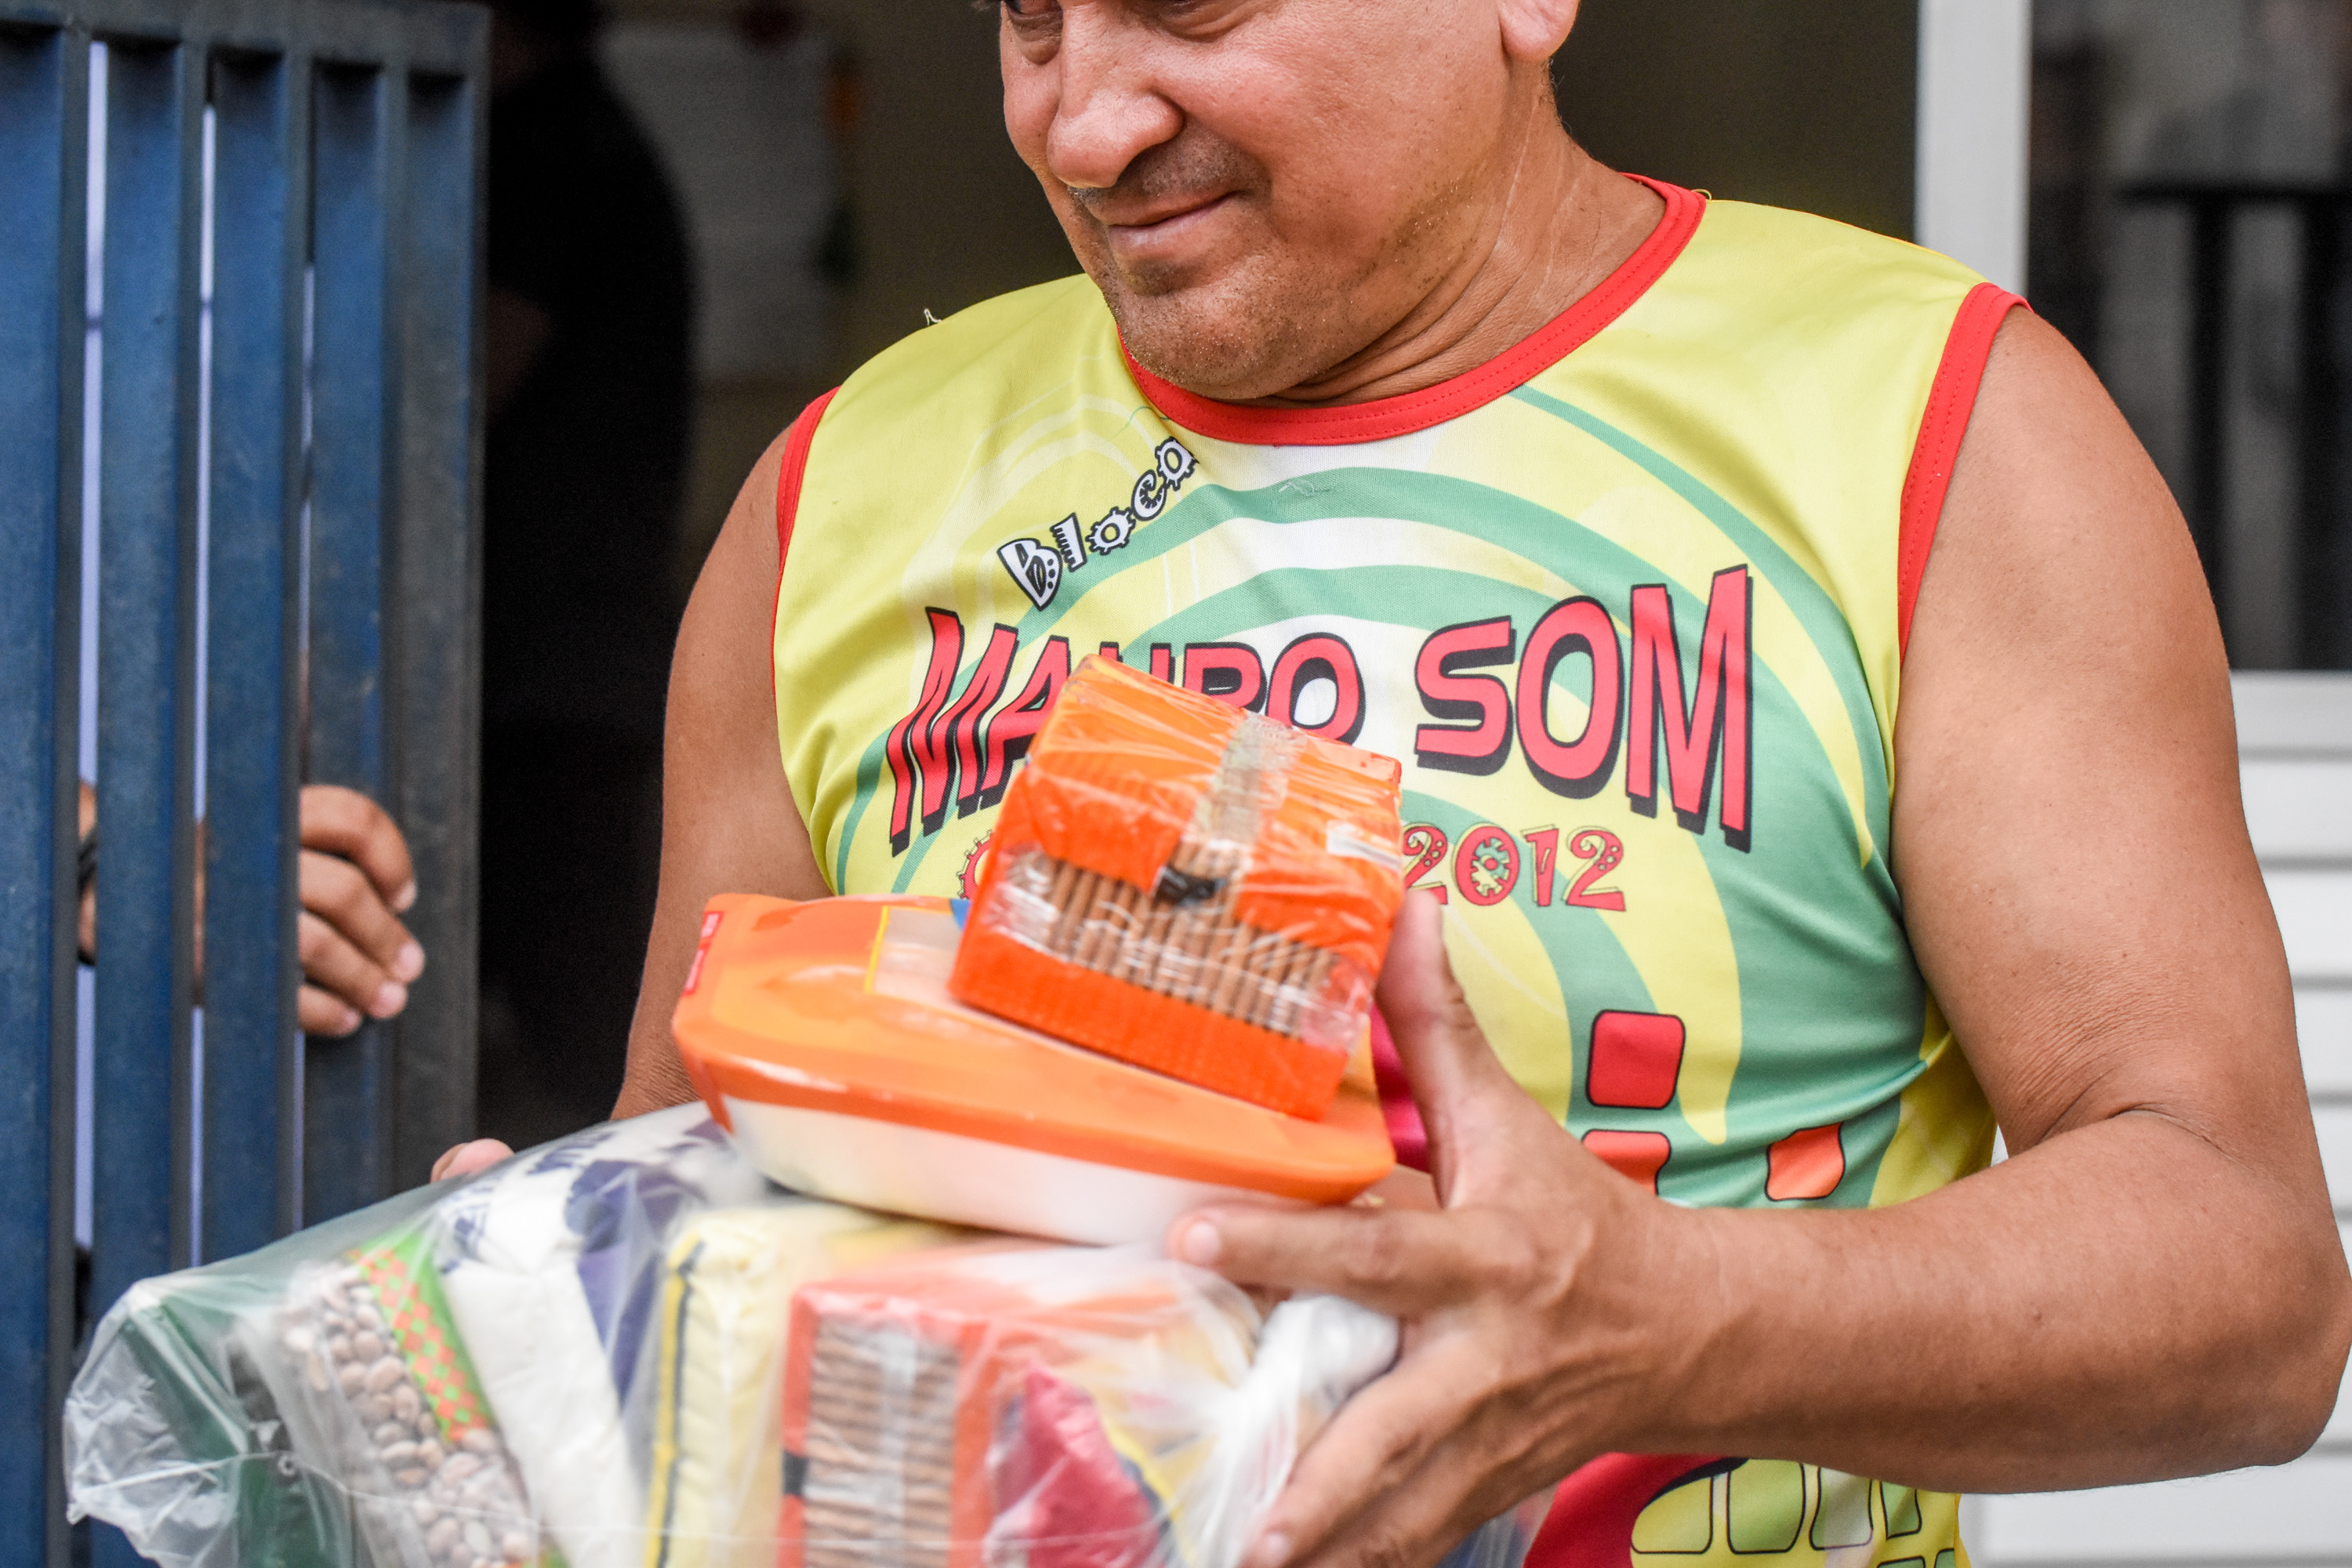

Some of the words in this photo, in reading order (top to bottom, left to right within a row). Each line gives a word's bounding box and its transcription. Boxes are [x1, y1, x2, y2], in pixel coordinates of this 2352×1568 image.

[996, 436, 1200, 612] Bloco
[1414, 564, 1753, 854] SOM
[1402, 821, 1627, 913] 2012
